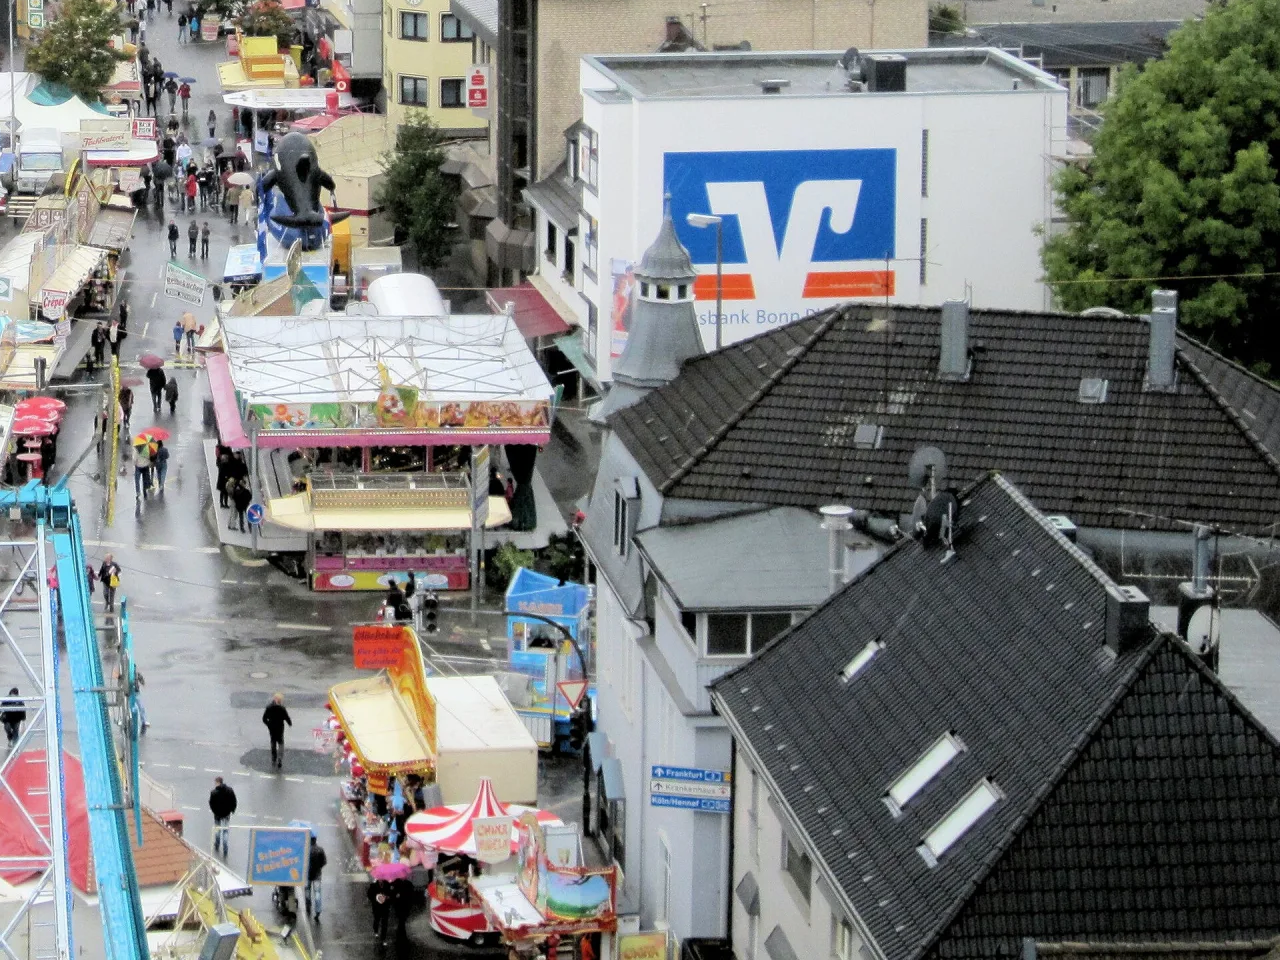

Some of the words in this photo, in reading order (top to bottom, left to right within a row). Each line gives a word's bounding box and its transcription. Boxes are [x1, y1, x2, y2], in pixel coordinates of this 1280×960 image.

[699, 309, 751, 326] sbank
[756, 309, 800, 325] Bonn
[665, 768, 703, 779] Frankfurt
[665, 784, 716, 795] Krankenhaus
[651, 795, 700, 807] Köln/Hennef
